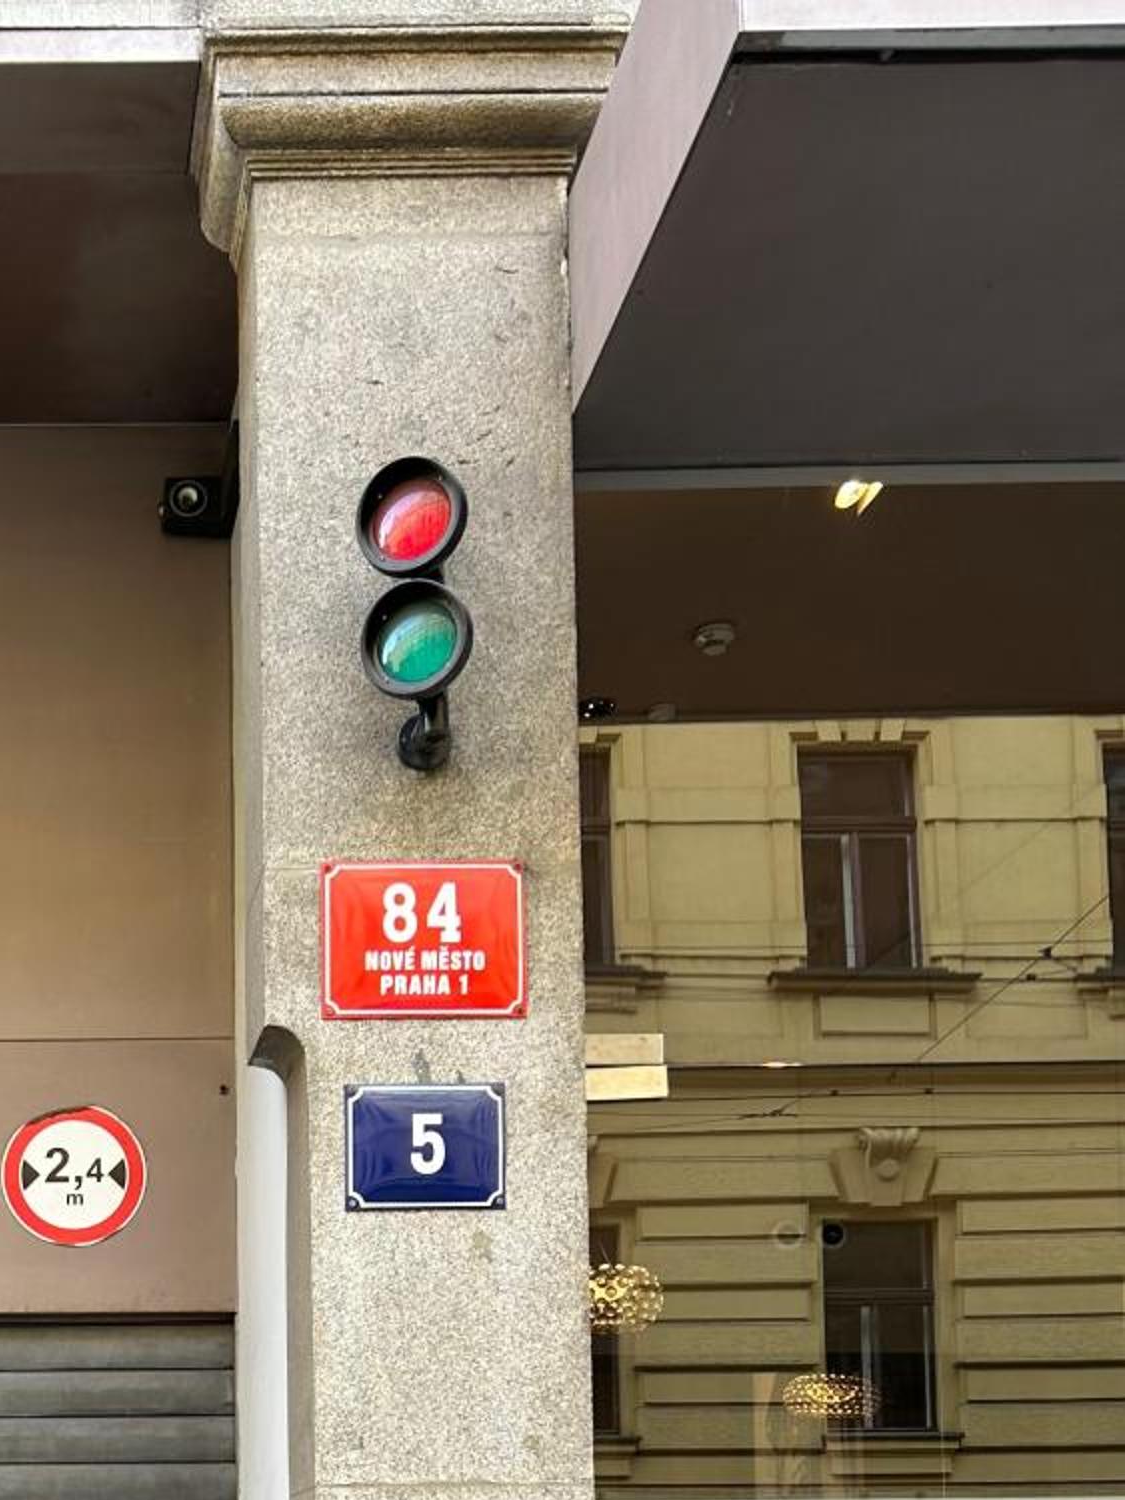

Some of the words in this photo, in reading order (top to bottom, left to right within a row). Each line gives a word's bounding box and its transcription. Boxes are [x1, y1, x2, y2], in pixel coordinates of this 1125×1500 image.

[382, 881, 462, 944] 84
[364, 946, 415, 971] NOVÉ
[420, 945, 485, 971] MĚSTO
[380, 974, 451, 995] PRAHA
[459, 974, 468, 995] 1
[409, 1113, 446, 1175] 5
[44, 1147, 105, 1190] 2,4
[66, 1193, 84, 1205] m
